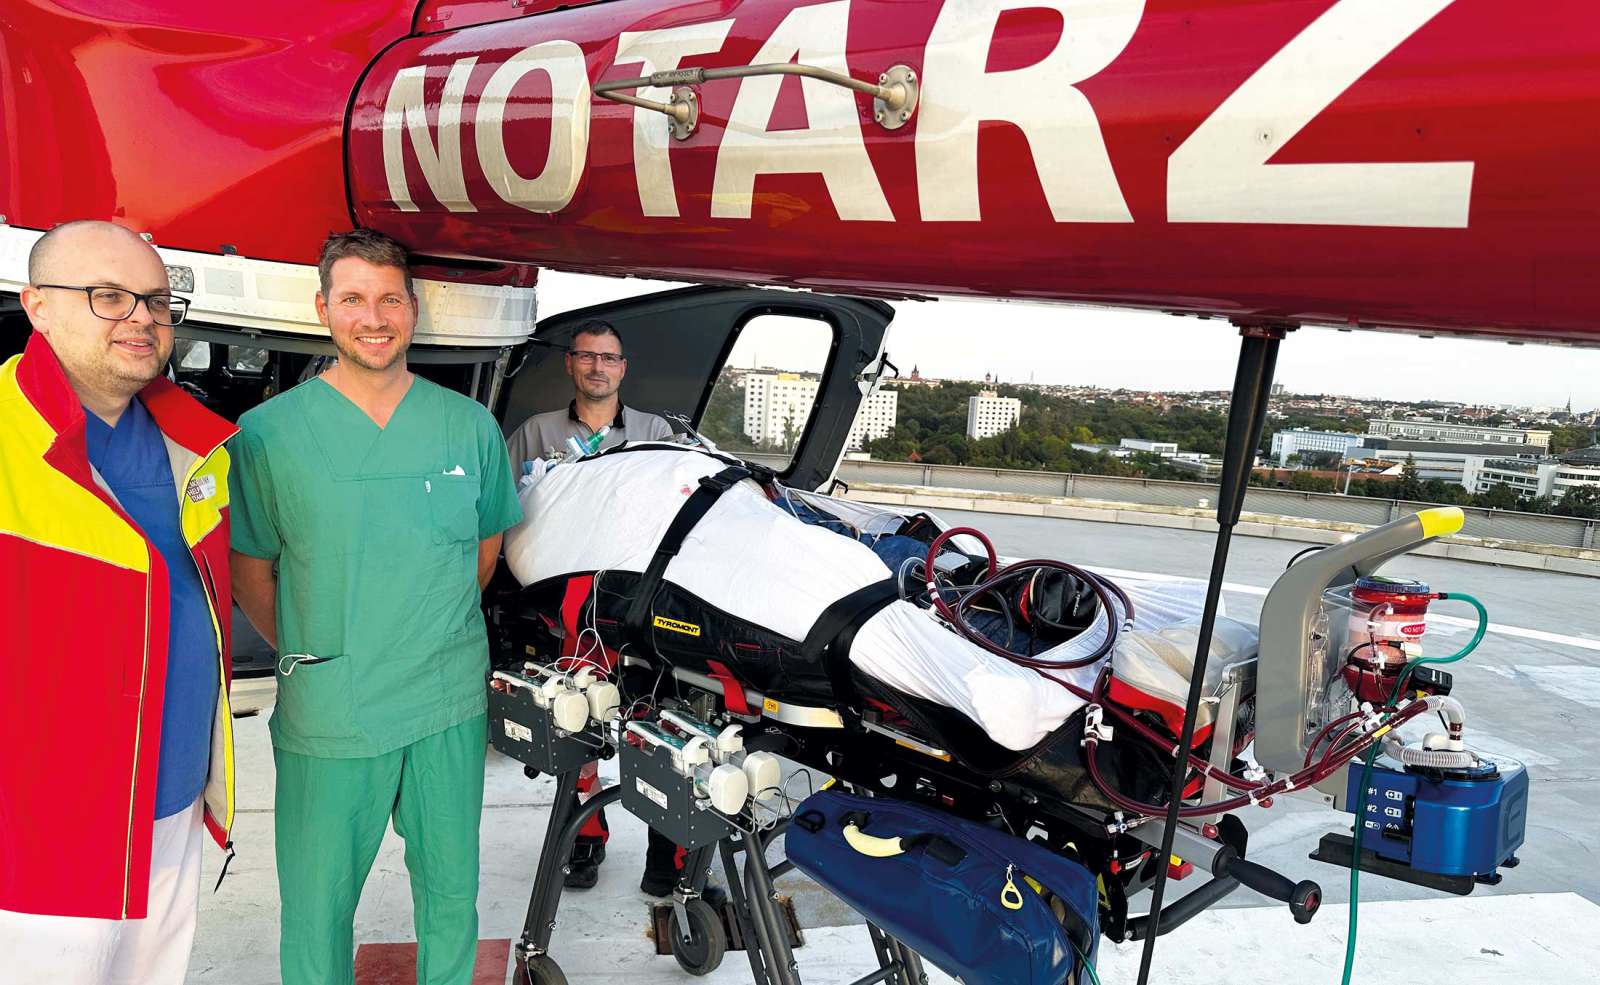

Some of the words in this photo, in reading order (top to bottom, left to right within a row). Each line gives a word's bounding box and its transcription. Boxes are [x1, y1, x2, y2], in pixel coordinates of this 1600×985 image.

[382, 0, 1475, 228] NOTARZ
[656, 618, 699, 634] TYROMONT
[1367, 787, 1377, 796] #1
[1367, 804, 1377, 813] #2
